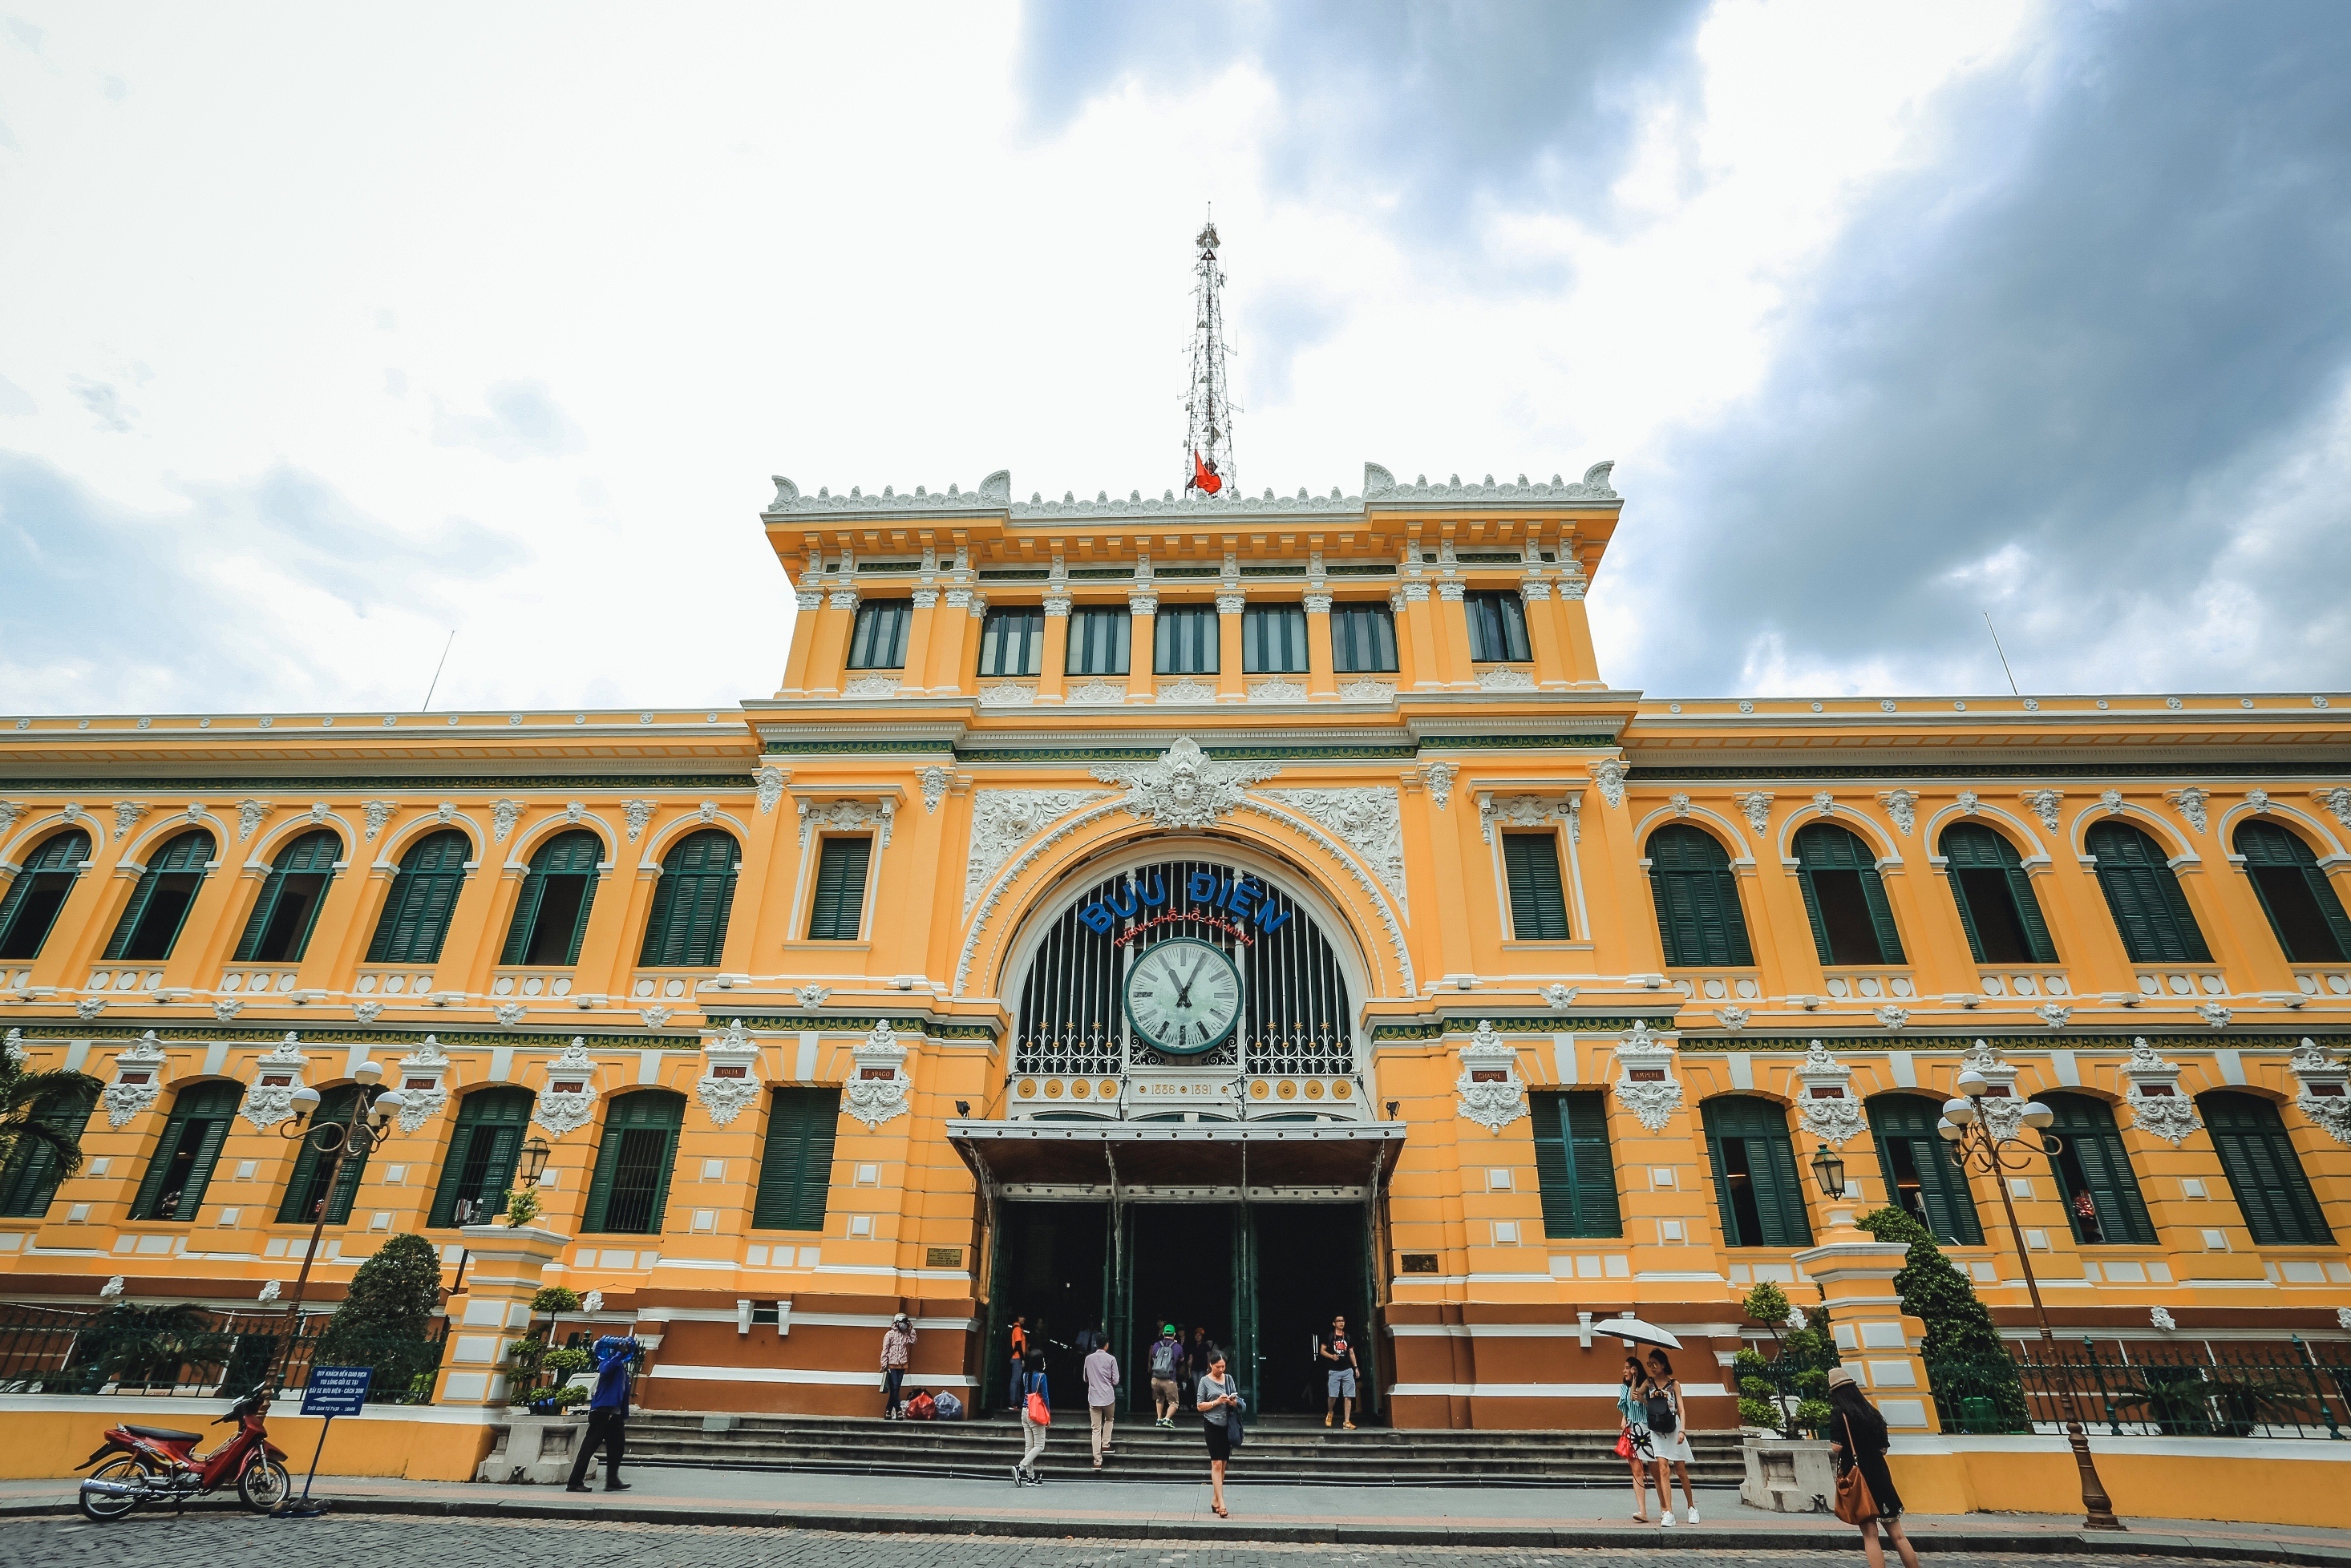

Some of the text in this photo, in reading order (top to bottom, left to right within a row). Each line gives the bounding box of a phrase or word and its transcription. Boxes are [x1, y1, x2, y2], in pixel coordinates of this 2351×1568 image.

[1078, 871, 1291, 935] BƯU ĐIỆN
[1114, 907, 1254, 948] THÀNH PHỐ HỒ CHÍ MINH
[1151, 1084, 1212, 1095] 1886 1891
[338, 1369, 348, 1377] ĐẾN
[330, 1387, 342, 1395] ĐIỆN
